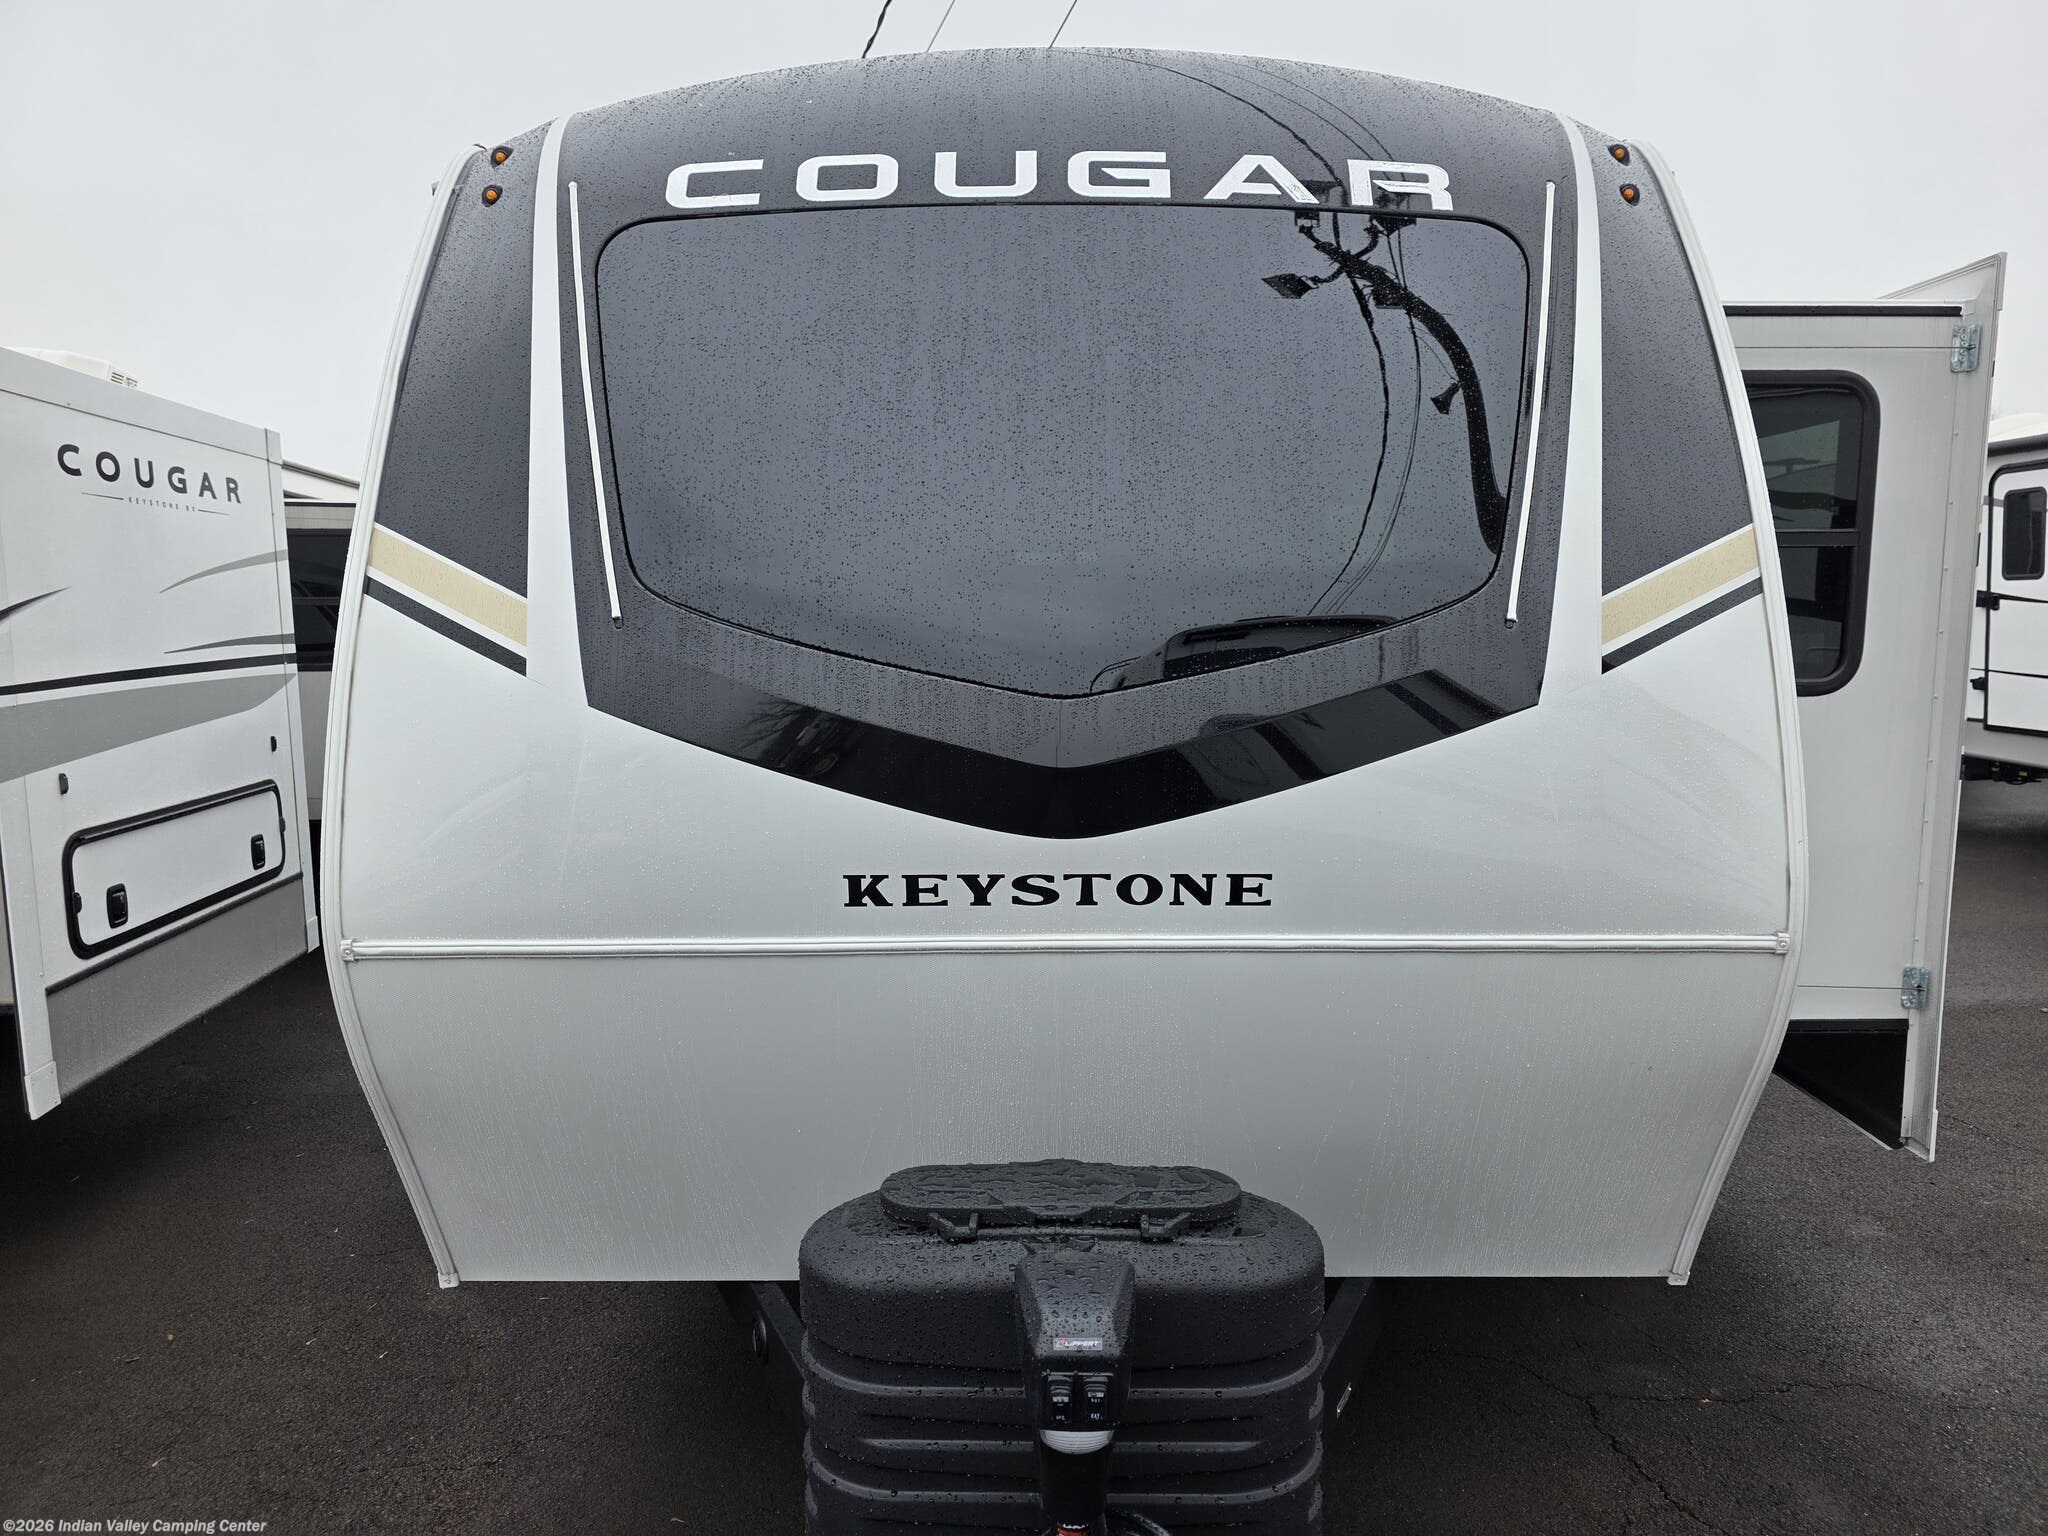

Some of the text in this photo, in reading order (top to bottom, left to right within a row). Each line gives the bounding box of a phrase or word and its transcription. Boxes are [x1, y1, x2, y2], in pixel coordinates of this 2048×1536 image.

[665, 150, 1454, 211] COUGAR
[57, 443, 241, 504] COUGAR
[843, 873, 1273, 907] KEYSTONE
